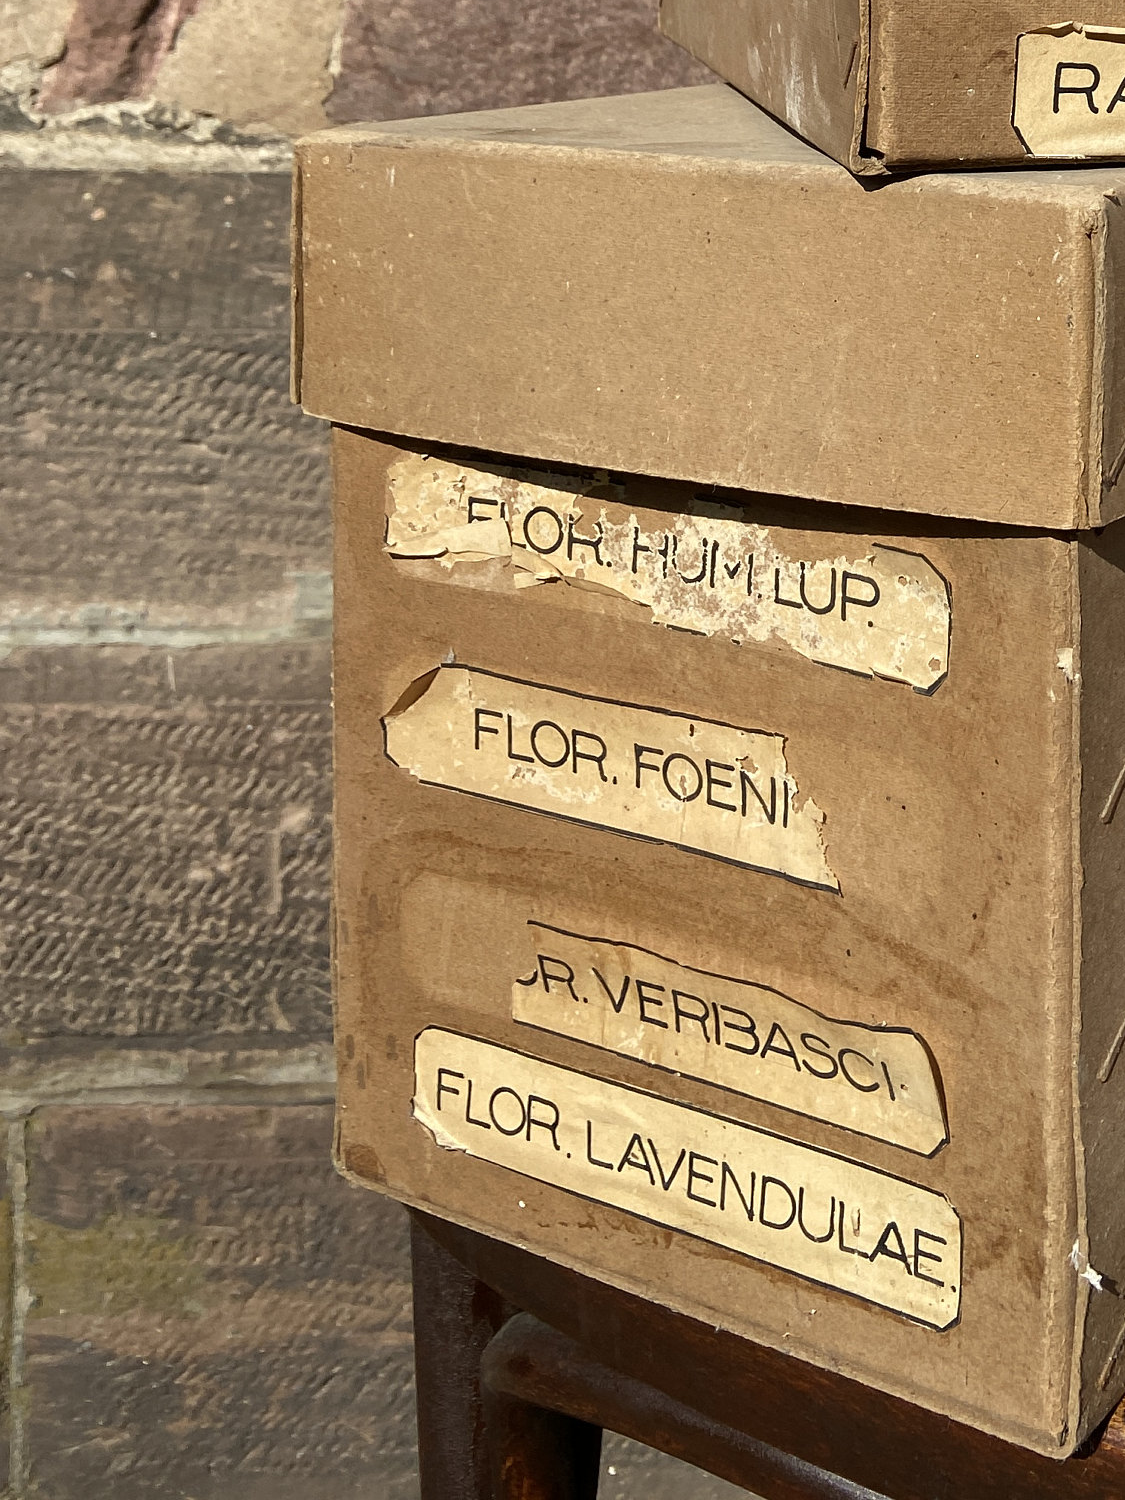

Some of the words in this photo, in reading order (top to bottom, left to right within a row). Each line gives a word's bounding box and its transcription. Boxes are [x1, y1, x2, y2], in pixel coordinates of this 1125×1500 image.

[473, 708, 618, 785] FLOR.
[633, 742, 790, 829] FOENI
[436, 1068, 571, 1159] FLOR.
[586, 1119, 957, 1293] LAVENDULAE.
